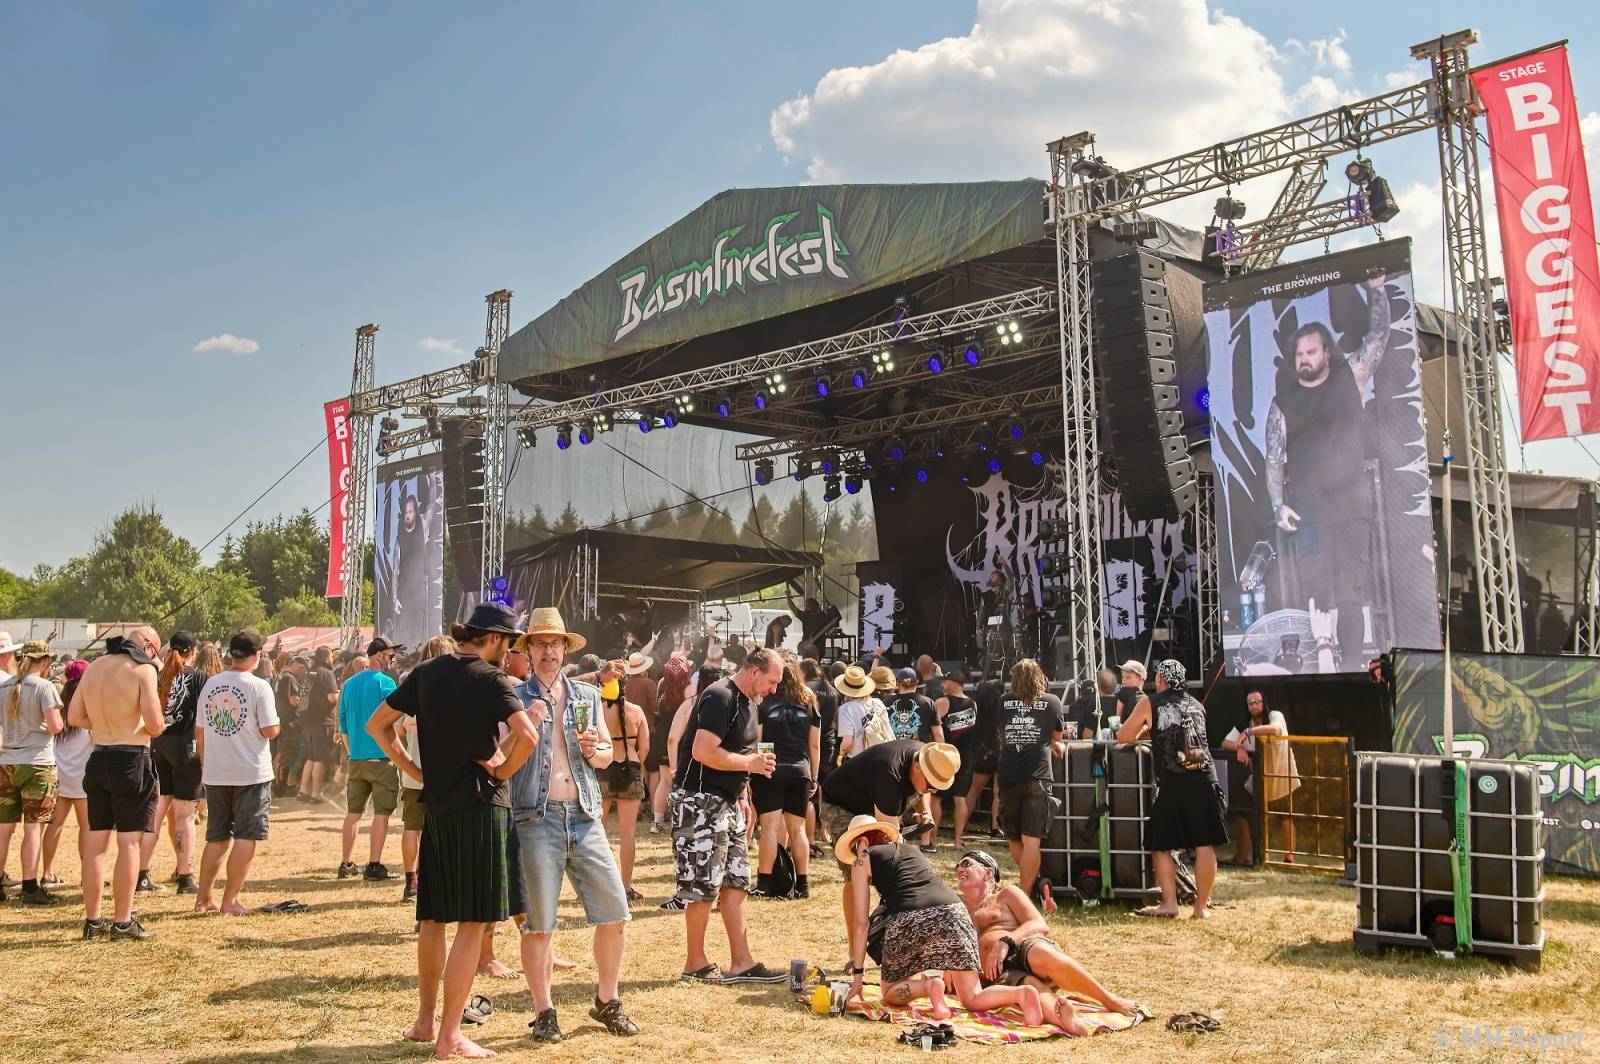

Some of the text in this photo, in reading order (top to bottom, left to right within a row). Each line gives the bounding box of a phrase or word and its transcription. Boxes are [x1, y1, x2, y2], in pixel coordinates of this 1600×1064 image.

[1498, 62, 1546, 81] STAGE
[1504, 82, 1592, 437] BIGGEST
[1261, 271, 1341, 295] THE BROWNING
[1003, 700, 1048, 708] METAEST
